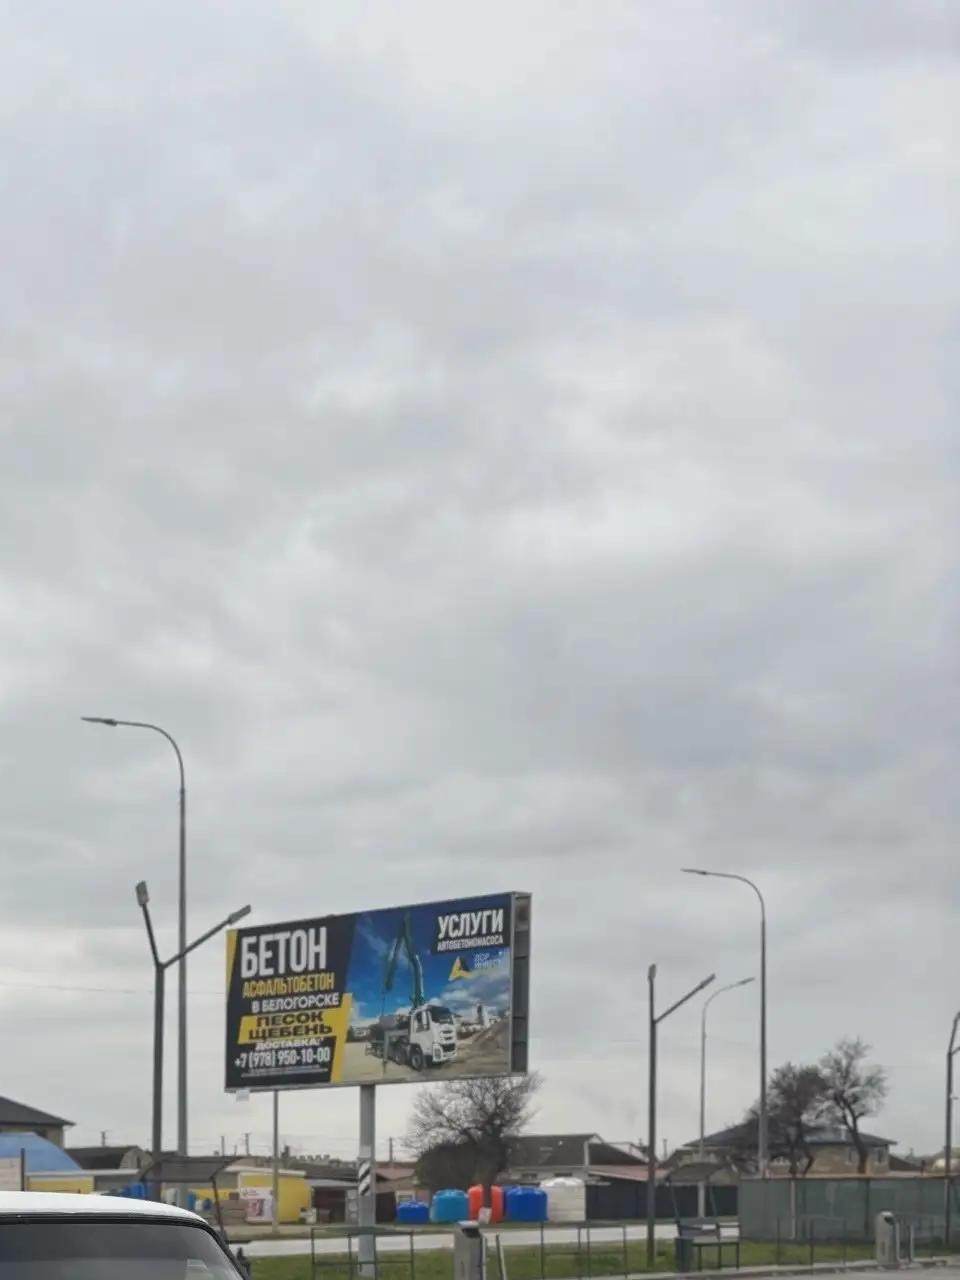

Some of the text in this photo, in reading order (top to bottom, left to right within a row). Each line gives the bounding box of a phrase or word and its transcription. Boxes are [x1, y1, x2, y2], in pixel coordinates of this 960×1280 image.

[437, 908, 504, 940] УСЛУГИ
[241, 926, 327, 978] БЕТОН
[243, 971, 335, 999] АСФАЛЬТОБЕТОН
[251, 992, 340, 1013] В БЕЛОГОРСКЕ
[256, 1010, 324, 1027] ПЕСОК
[248, 1023, 333, 1041] ЩЕБЕНЬ
[234, 1047, 331, 1068] +7 (978) 950-10-00
